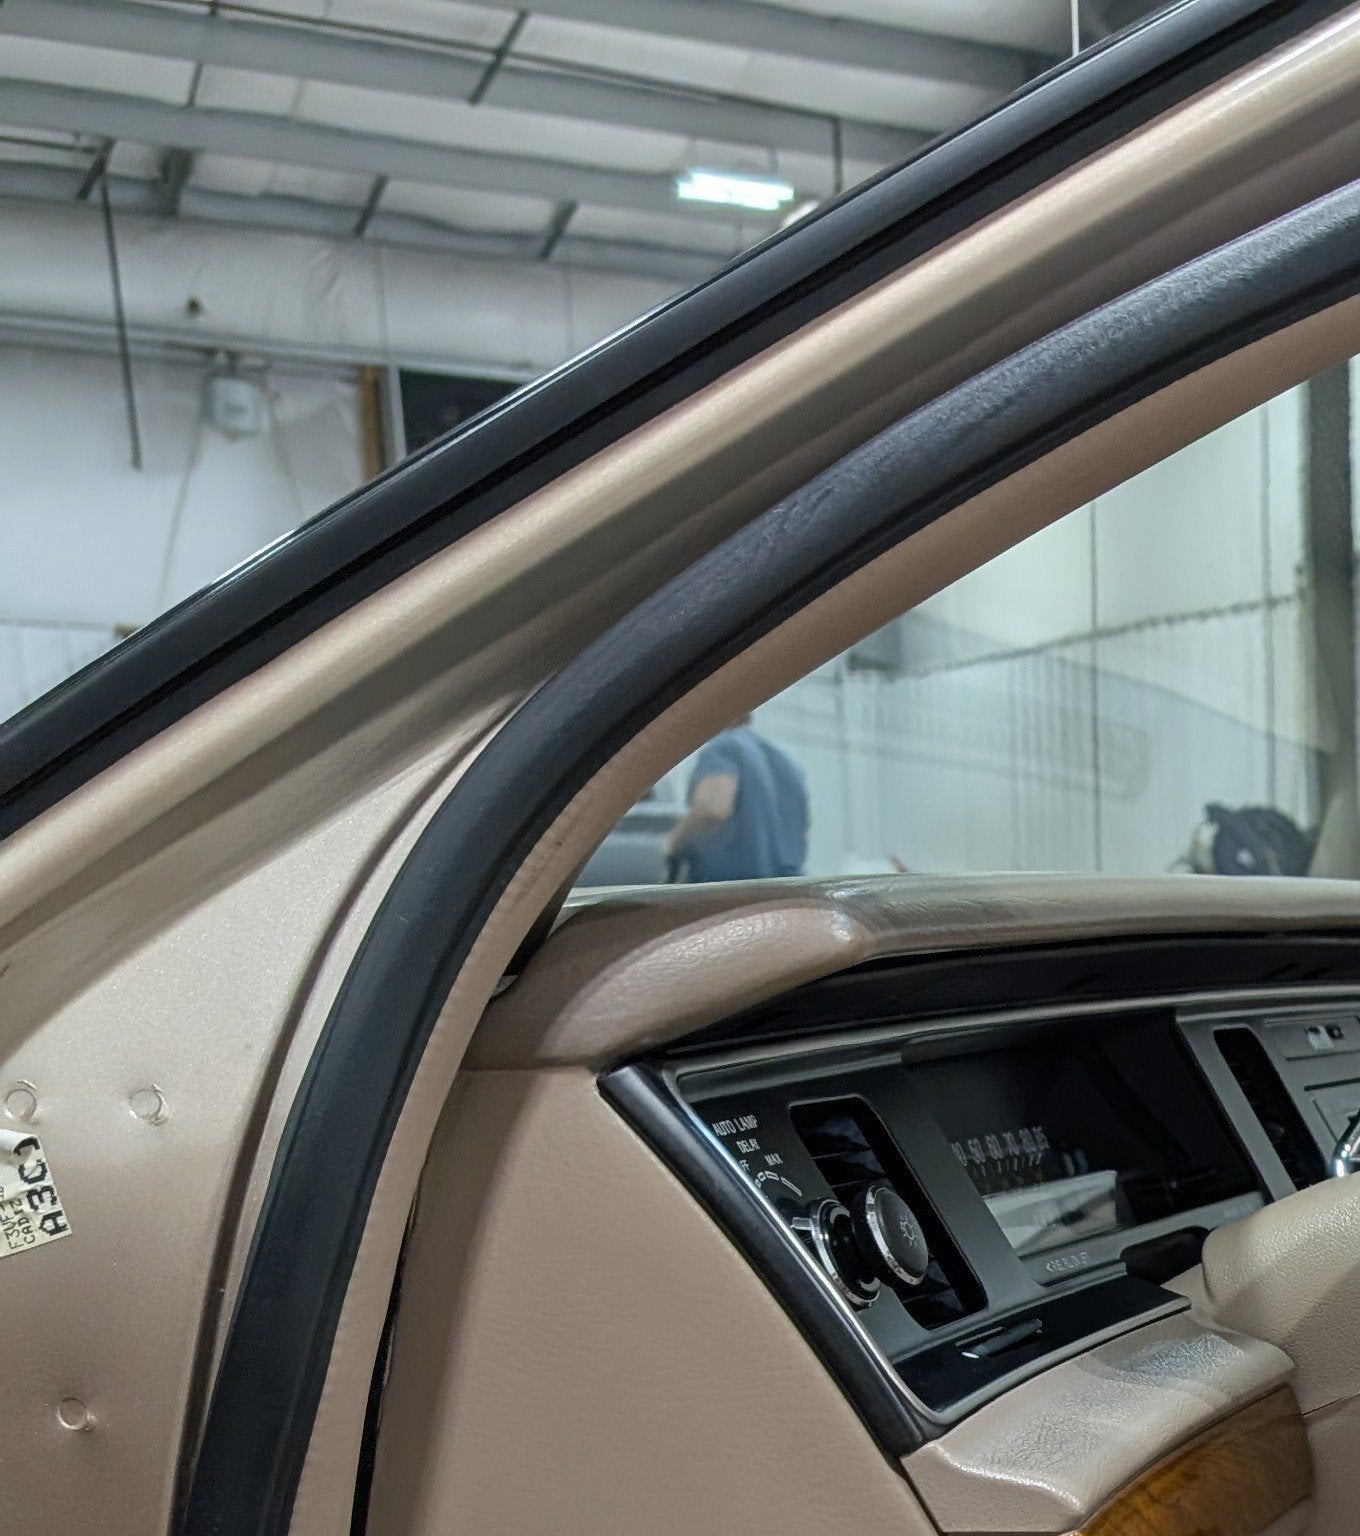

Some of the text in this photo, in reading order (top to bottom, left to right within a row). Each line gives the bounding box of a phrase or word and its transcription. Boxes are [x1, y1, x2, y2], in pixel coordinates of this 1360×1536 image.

[712, 1114, 759, 1136] AUTO LAMP
[736, 1138, 760, 1154] DELAY
